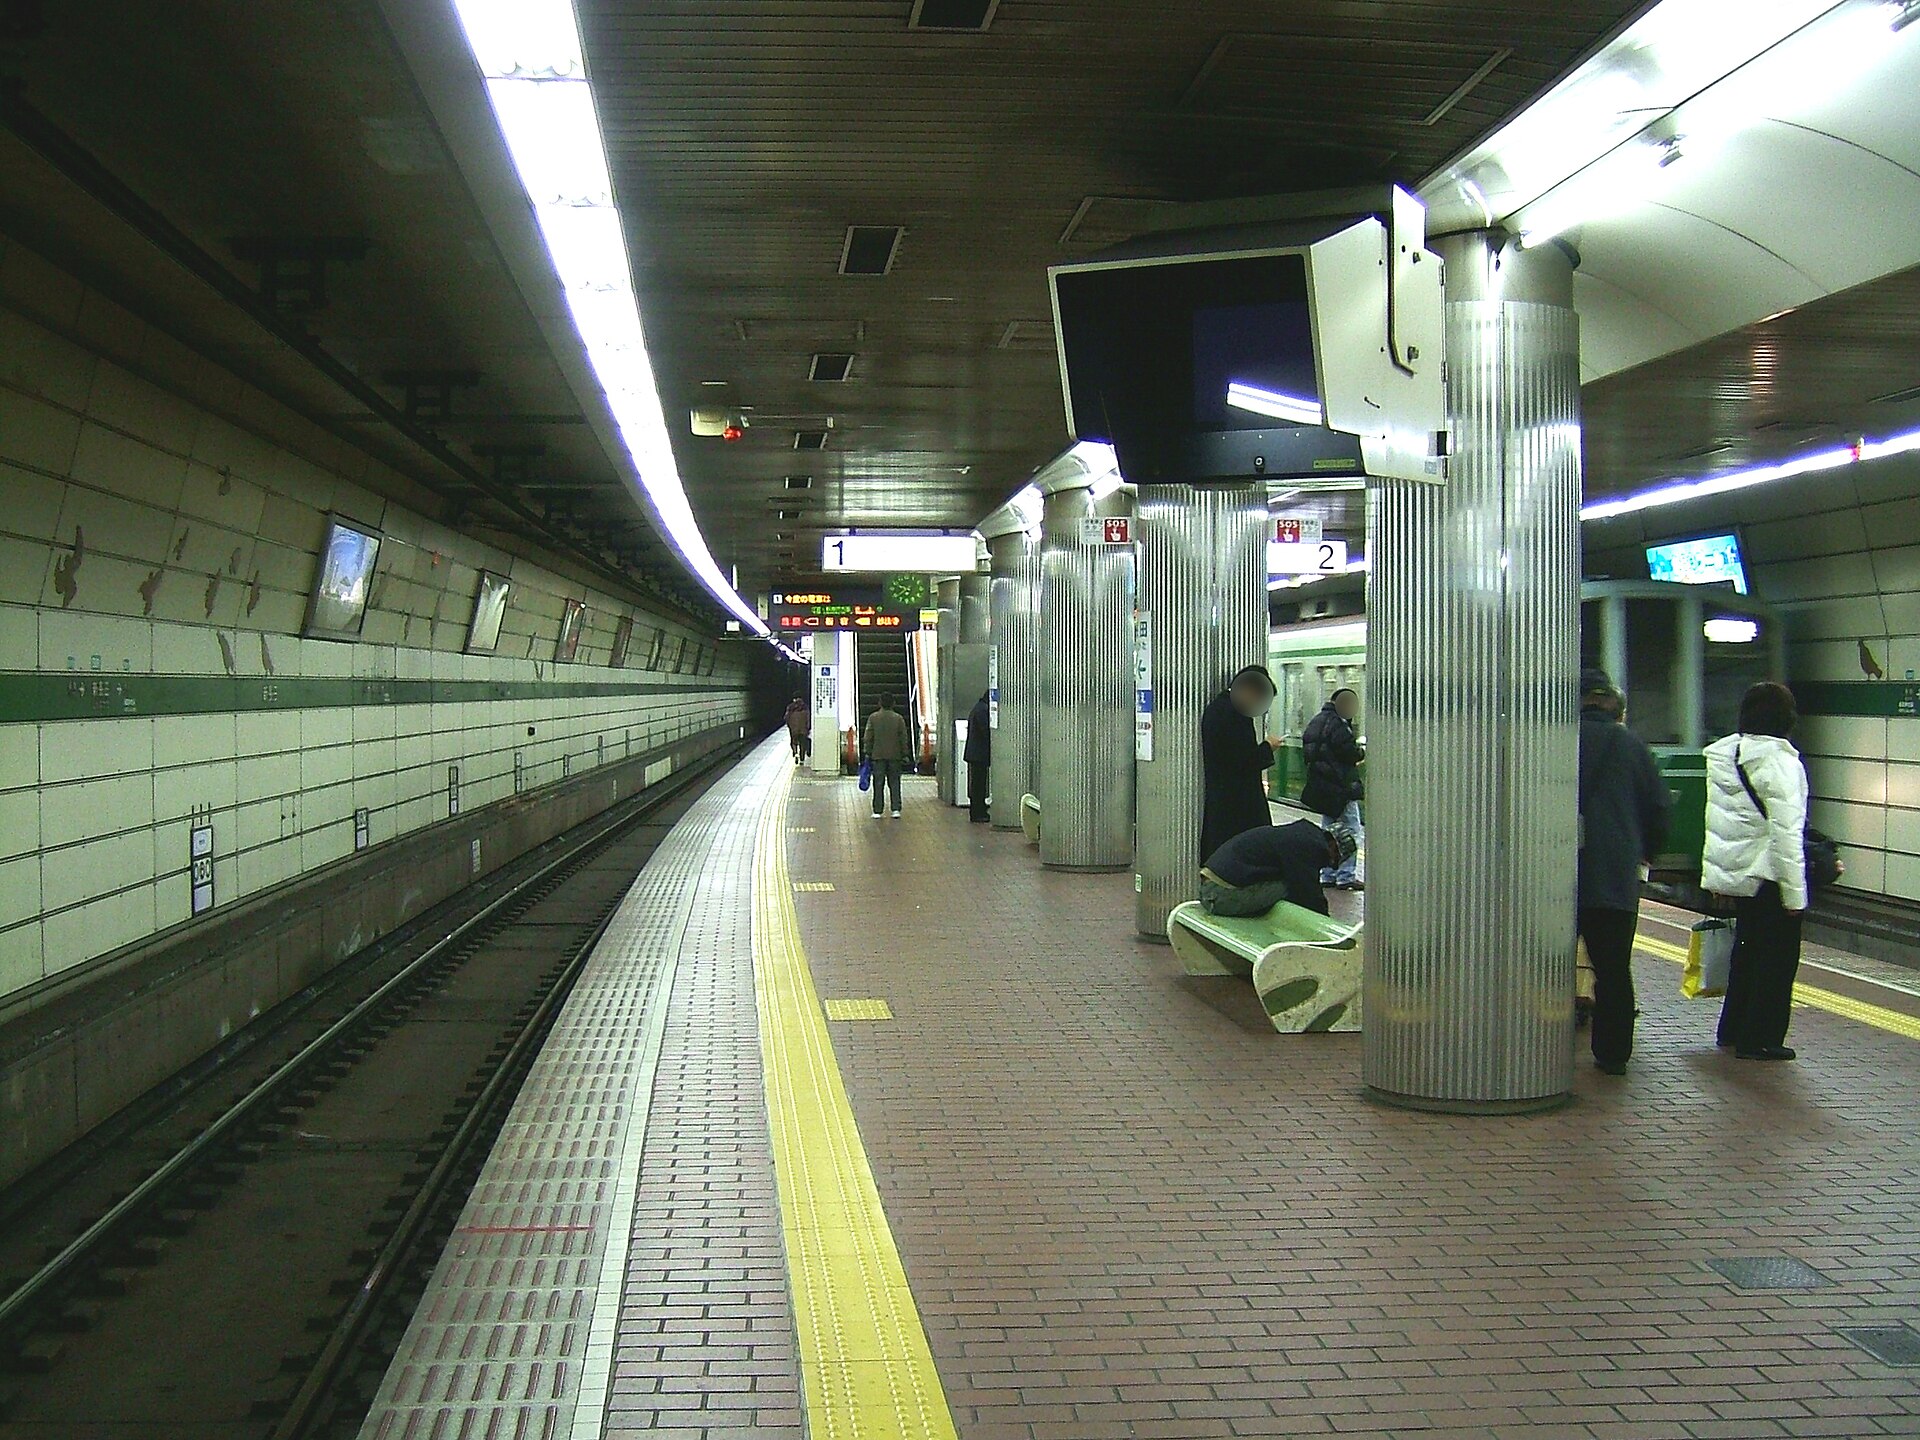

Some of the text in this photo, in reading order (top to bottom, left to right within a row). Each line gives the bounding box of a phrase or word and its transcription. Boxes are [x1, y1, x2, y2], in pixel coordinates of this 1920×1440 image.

[1106, 520, 1126, 528] SOS
[1279, 520, 1298, 528] SOS
[832, 540, 844, 566] 1
[1318, 545, 1334, 570] 2
